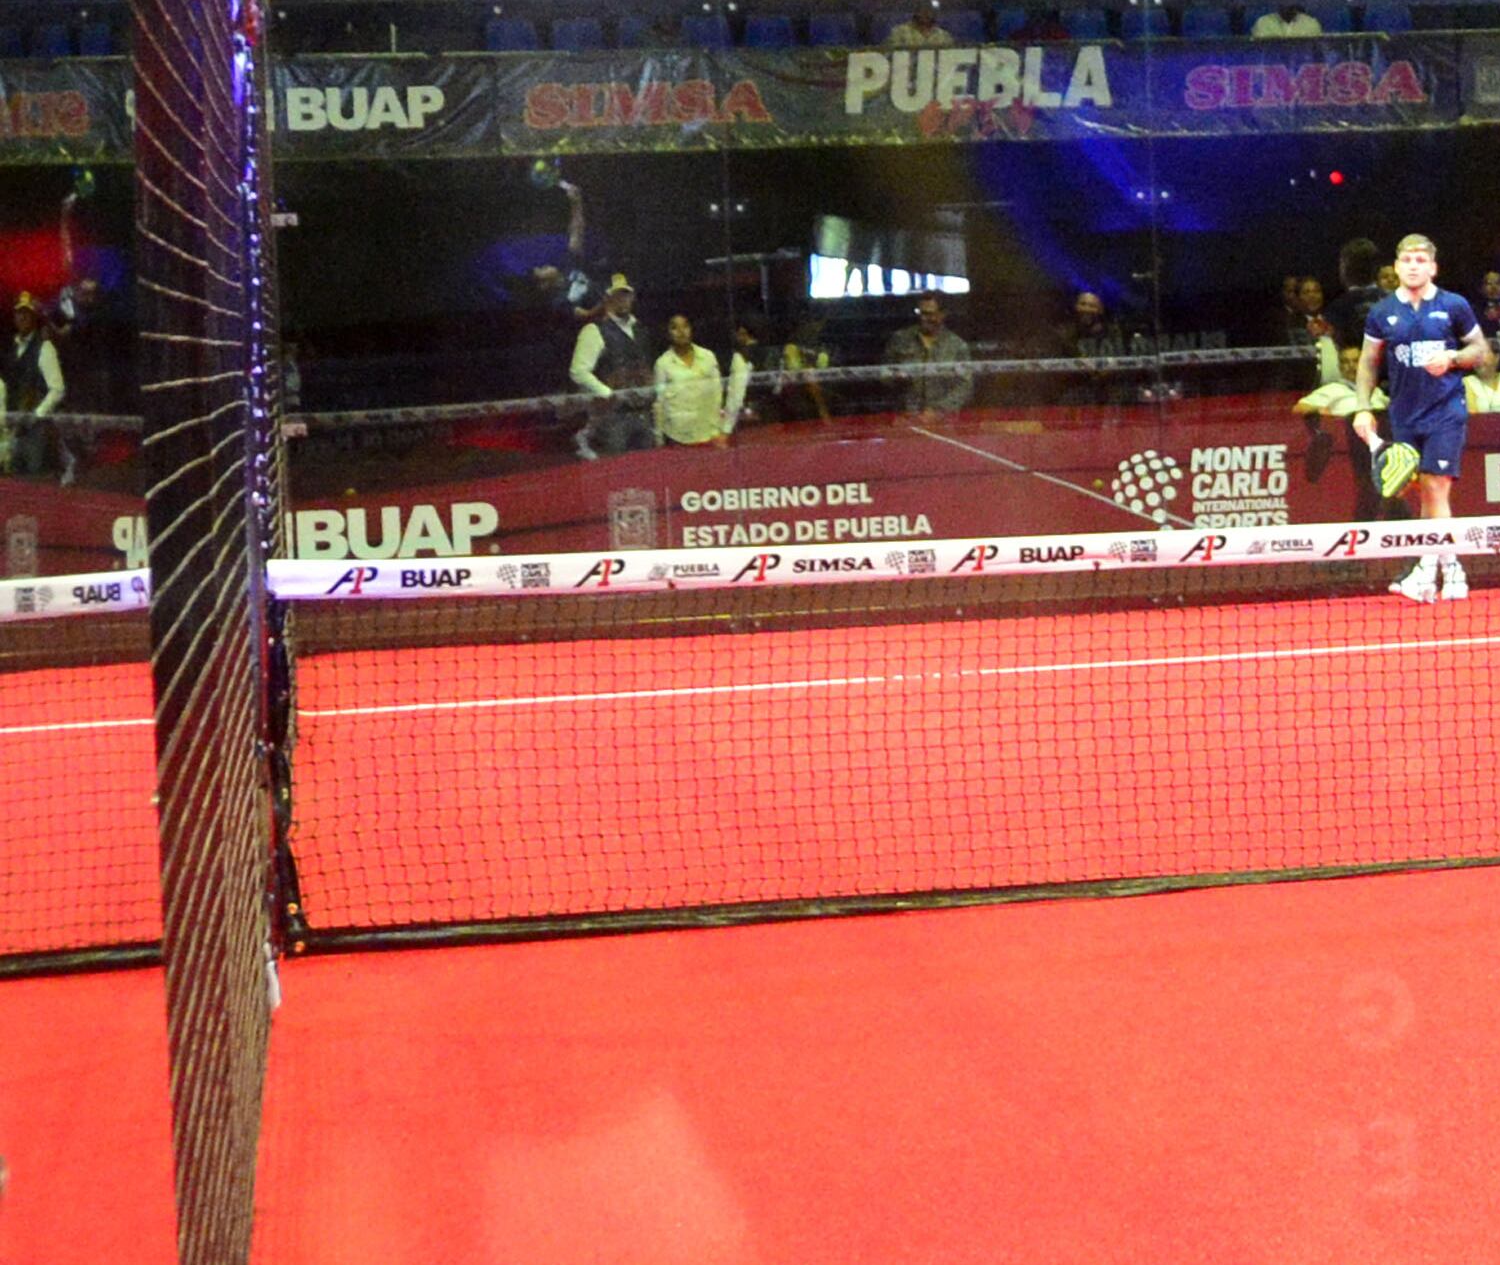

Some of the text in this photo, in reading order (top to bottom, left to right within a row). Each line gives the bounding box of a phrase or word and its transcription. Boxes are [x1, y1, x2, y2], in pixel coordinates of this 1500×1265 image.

[525, 80, 773, 127] SIMSA
[845, 46, 1112, 115] PUEBLA
[1184, 61, 1425, 110] SIMSA
[286, 85, 445, 132] BUAP
[1190, 444, 1288, 473] MONTE
[681, 482, 872, 512] GOBIERNO DEL
[1192, 470, 1288, 499] CARLO
[297, 501, 499, 560] BUAP
[682, 514, 931, 548] ESTADO DE PUEBLA
[401, 568, 471, 588] BUAP
[673, 563, 720, 574] PUEBLA
[792, 557, 874, 573] SIMSA
[1019, 545, 1084, 563] BUAP
[1271, 538, 1313, 548] PUEBLA
[1380, 532, 1455, 548] SIMSA
